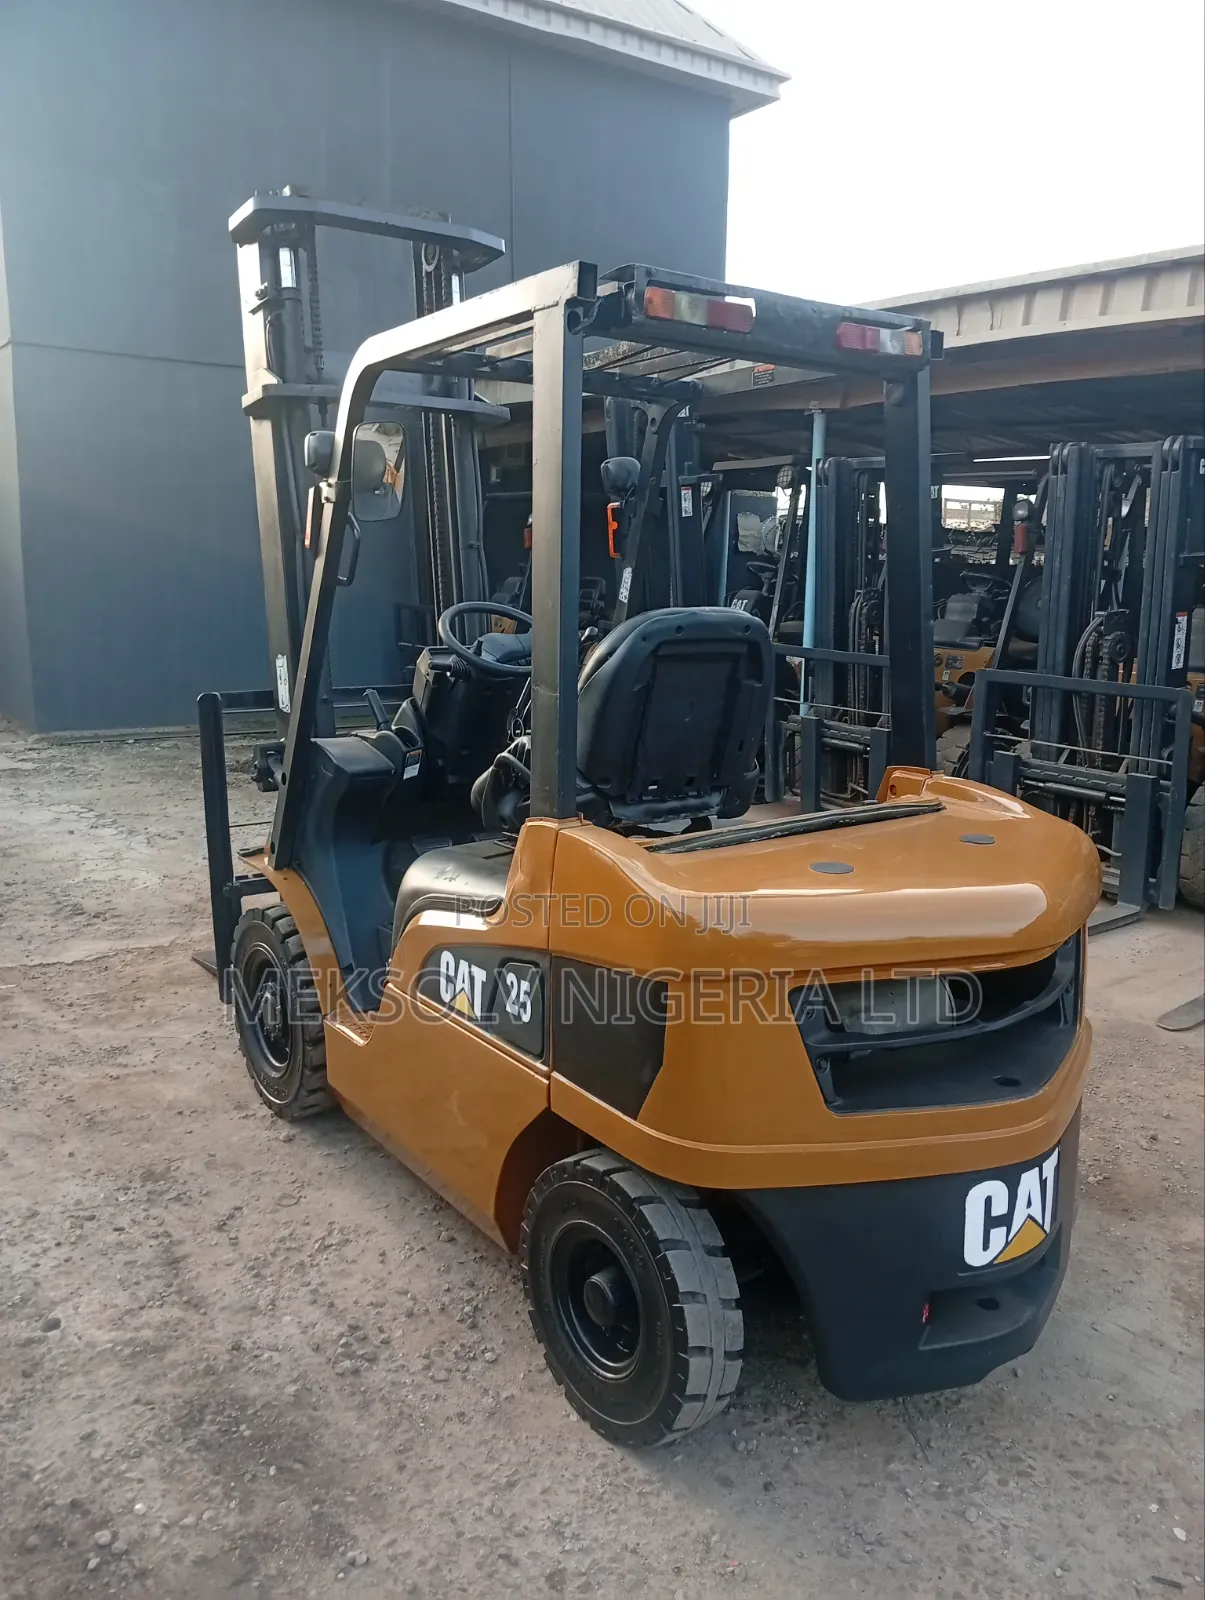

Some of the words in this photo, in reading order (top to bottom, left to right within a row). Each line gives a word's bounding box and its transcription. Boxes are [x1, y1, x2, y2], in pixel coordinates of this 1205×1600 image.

[731, 599, 748, 611] CAT
[439, 950, 487, 1023] CAT
[506, 972, 532, 1023] 25
[963, 1145, 1060, 1267] CAT
